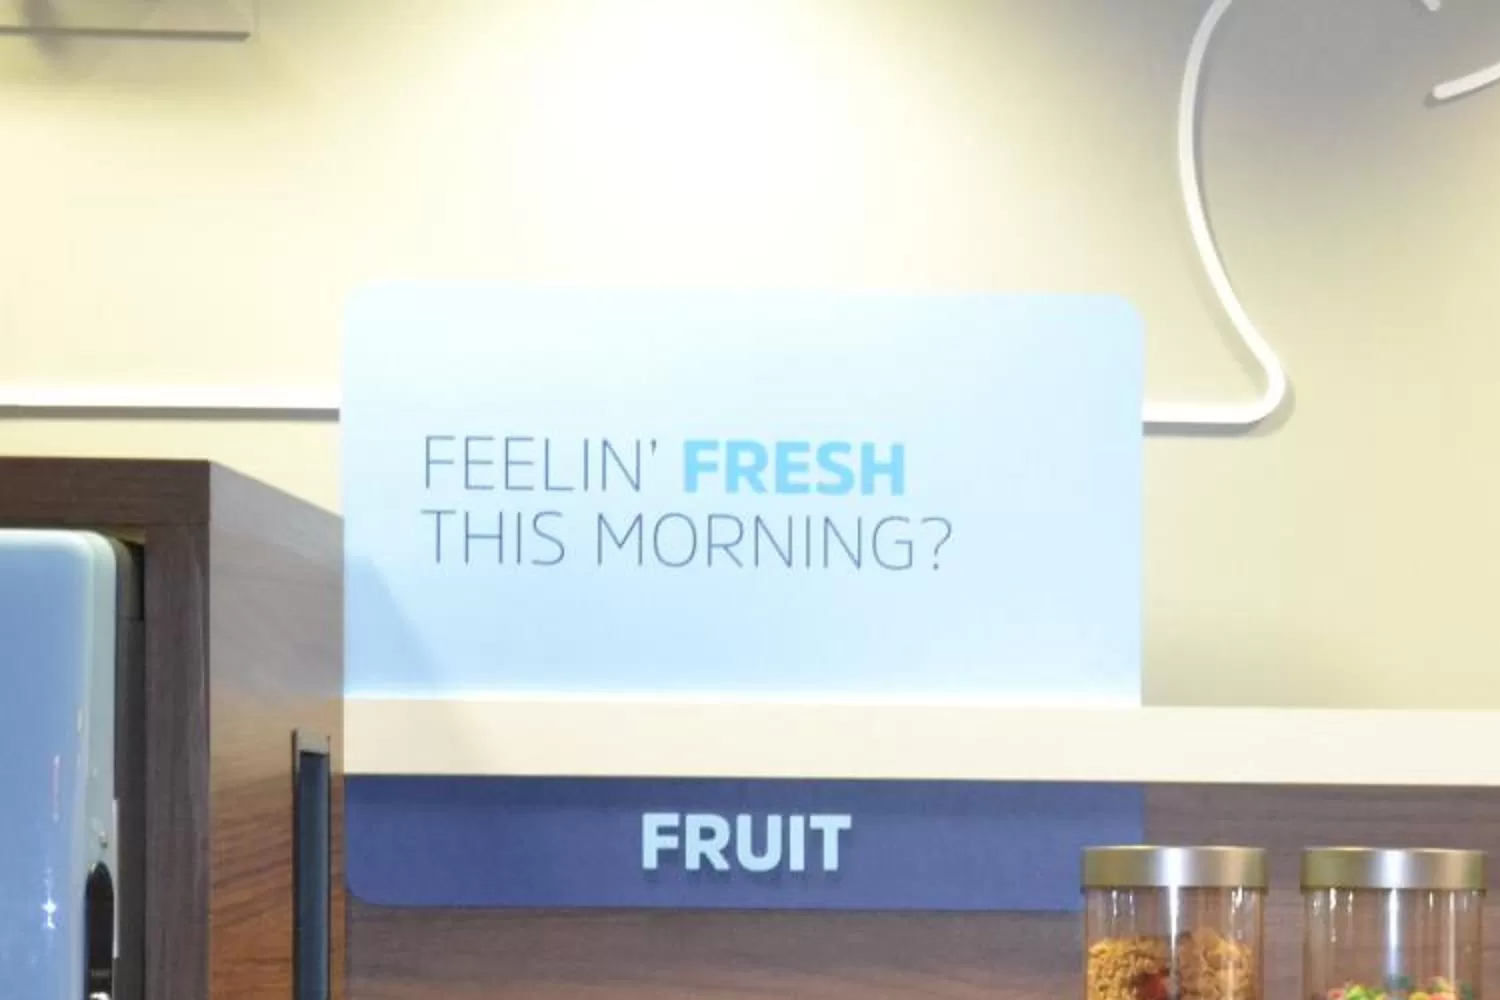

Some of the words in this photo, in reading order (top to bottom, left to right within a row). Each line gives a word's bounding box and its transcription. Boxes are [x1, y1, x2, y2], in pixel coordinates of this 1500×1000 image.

[682, 439, 906, 496] FRESH
[420, 509, 566, 566] THIS
[597, 511, 953, 571] MORNING?
[642, 812, 852, 871] FRUIT
